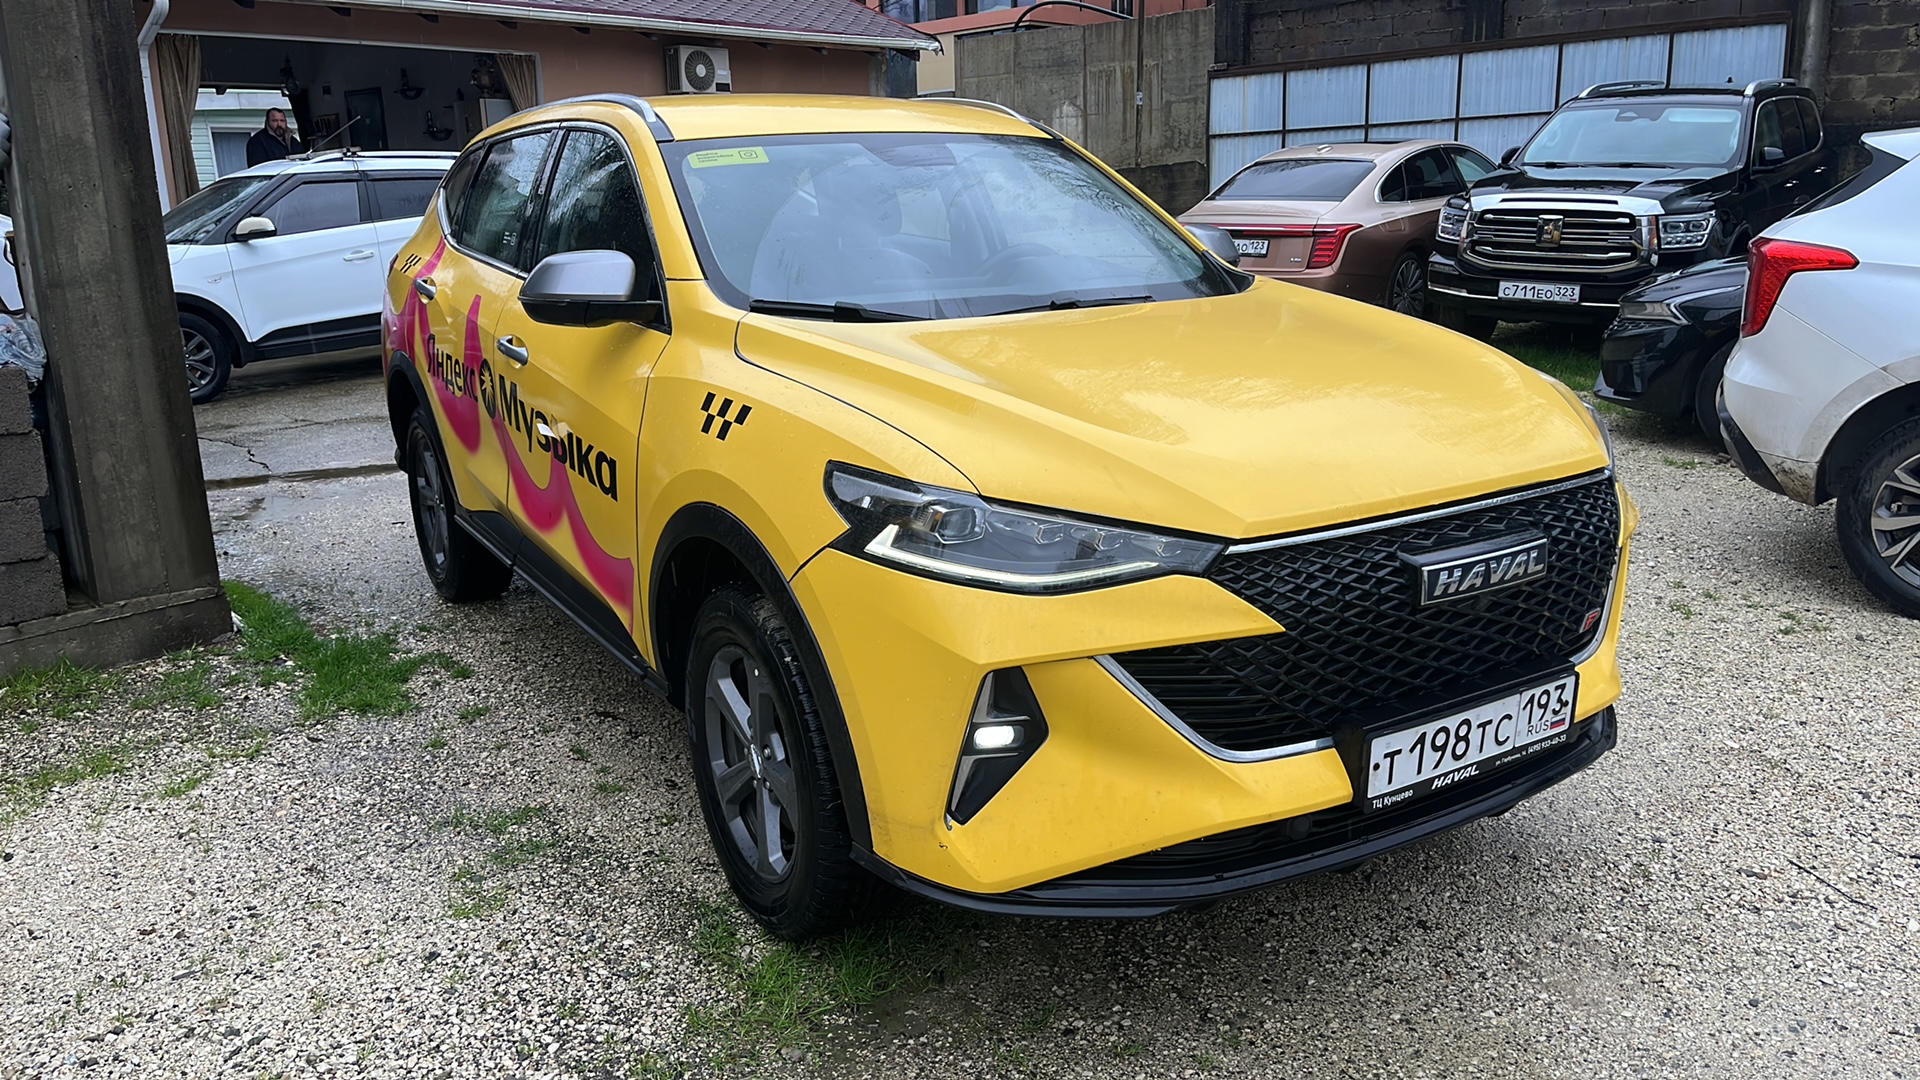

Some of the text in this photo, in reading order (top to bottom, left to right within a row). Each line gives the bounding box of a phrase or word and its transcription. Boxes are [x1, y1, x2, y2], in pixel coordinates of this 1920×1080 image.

[1250, 241, 1265, 250] 123
[1503, 285, 1576, 299] С711ЕО 323
[427, 333, 619, 502] Яндекс Музыка
[1433, 548, 1545, 596] HAVAL
[1383, 683, 1567, 785] Т198ТС 193
[1526, 719, 1550, 737] RUS
[1431, 764, 1480, 790] HAVAL
[1372, 789, 1414, 809] ТЦ Кунцево
